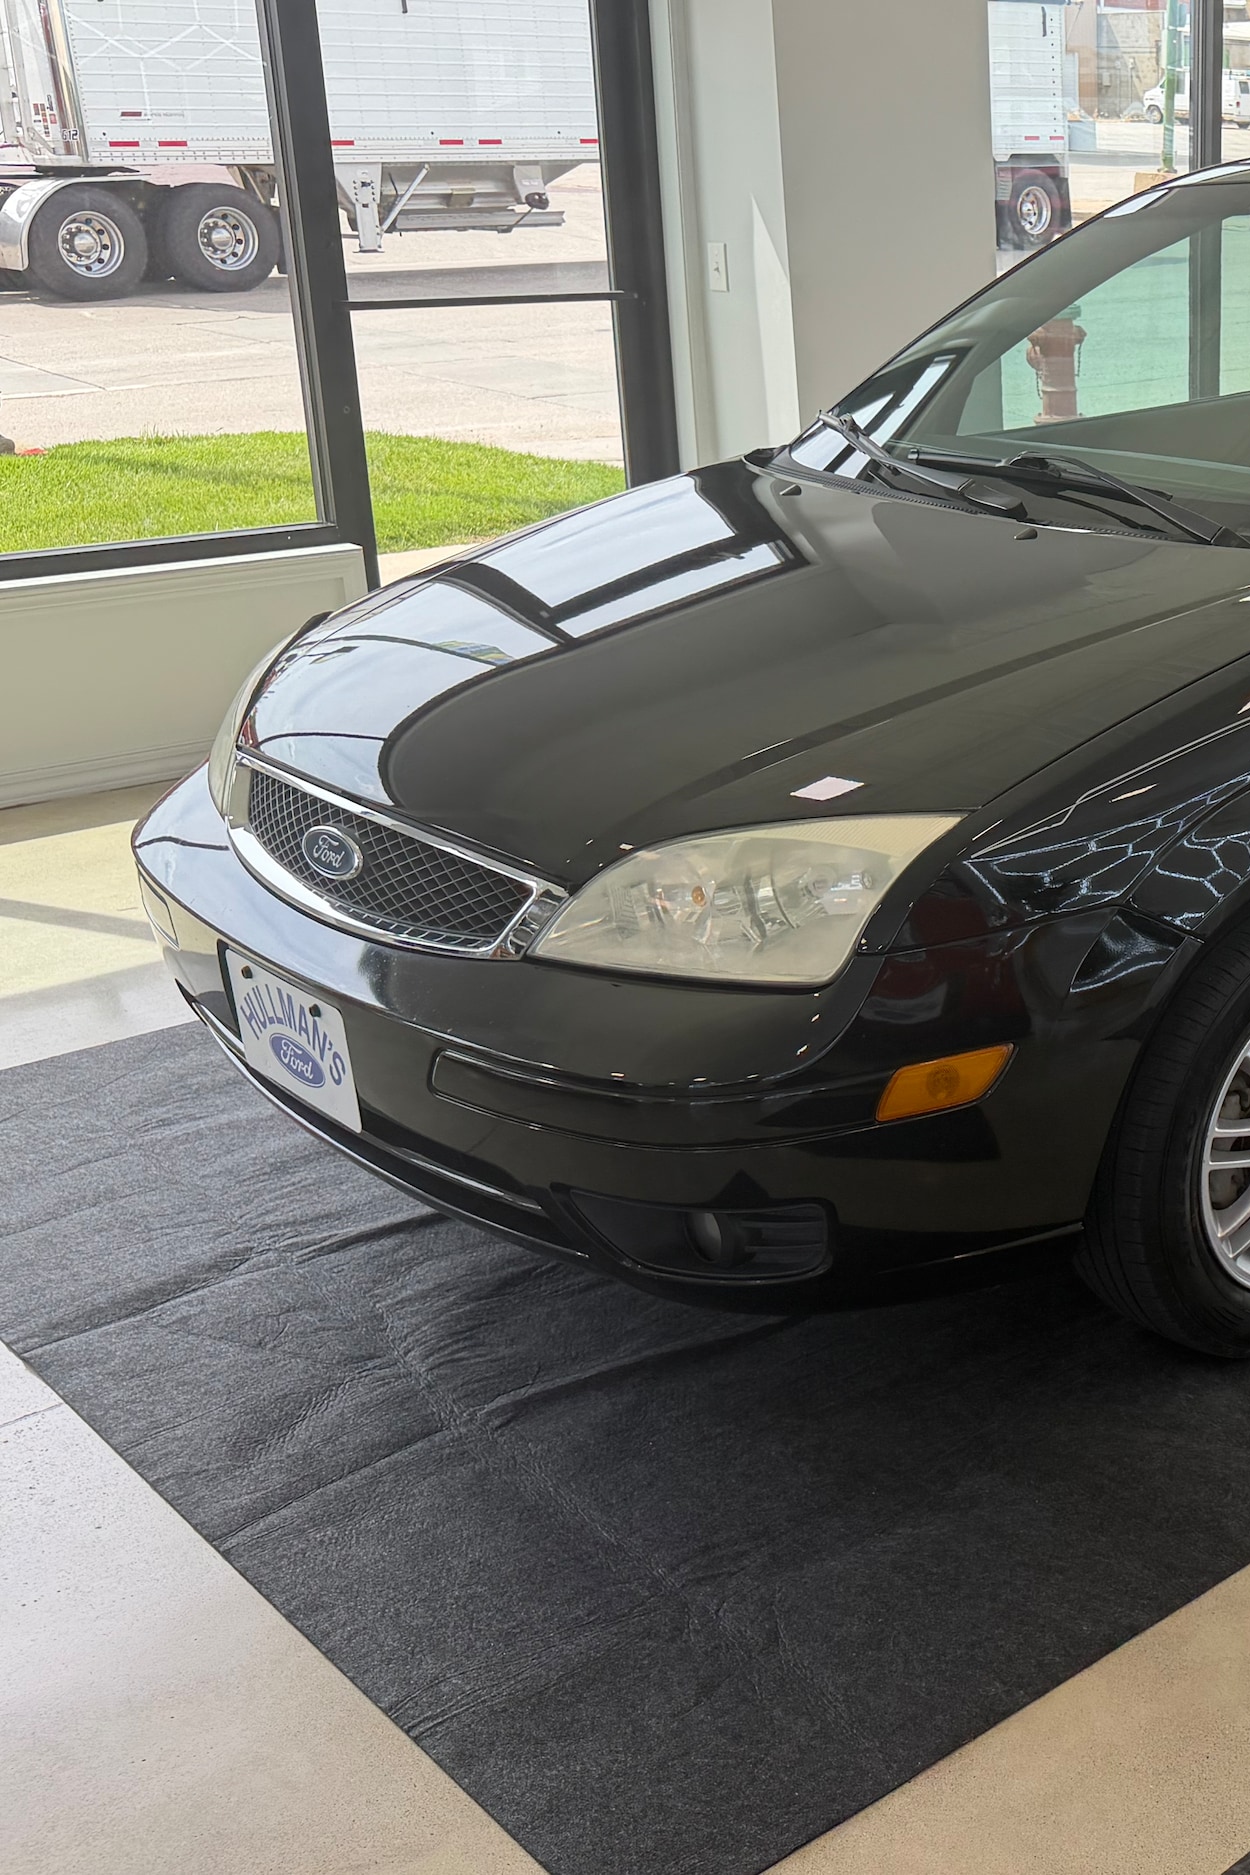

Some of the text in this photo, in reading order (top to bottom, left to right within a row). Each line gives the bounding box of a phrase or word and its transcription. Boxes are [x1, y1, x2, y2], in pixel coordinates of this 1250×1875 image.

[313, 835, 345, 869] Ford
[240, 983, 347, 1087] HULLMAN'S
[280, 1041, 314, 1080] Ford
